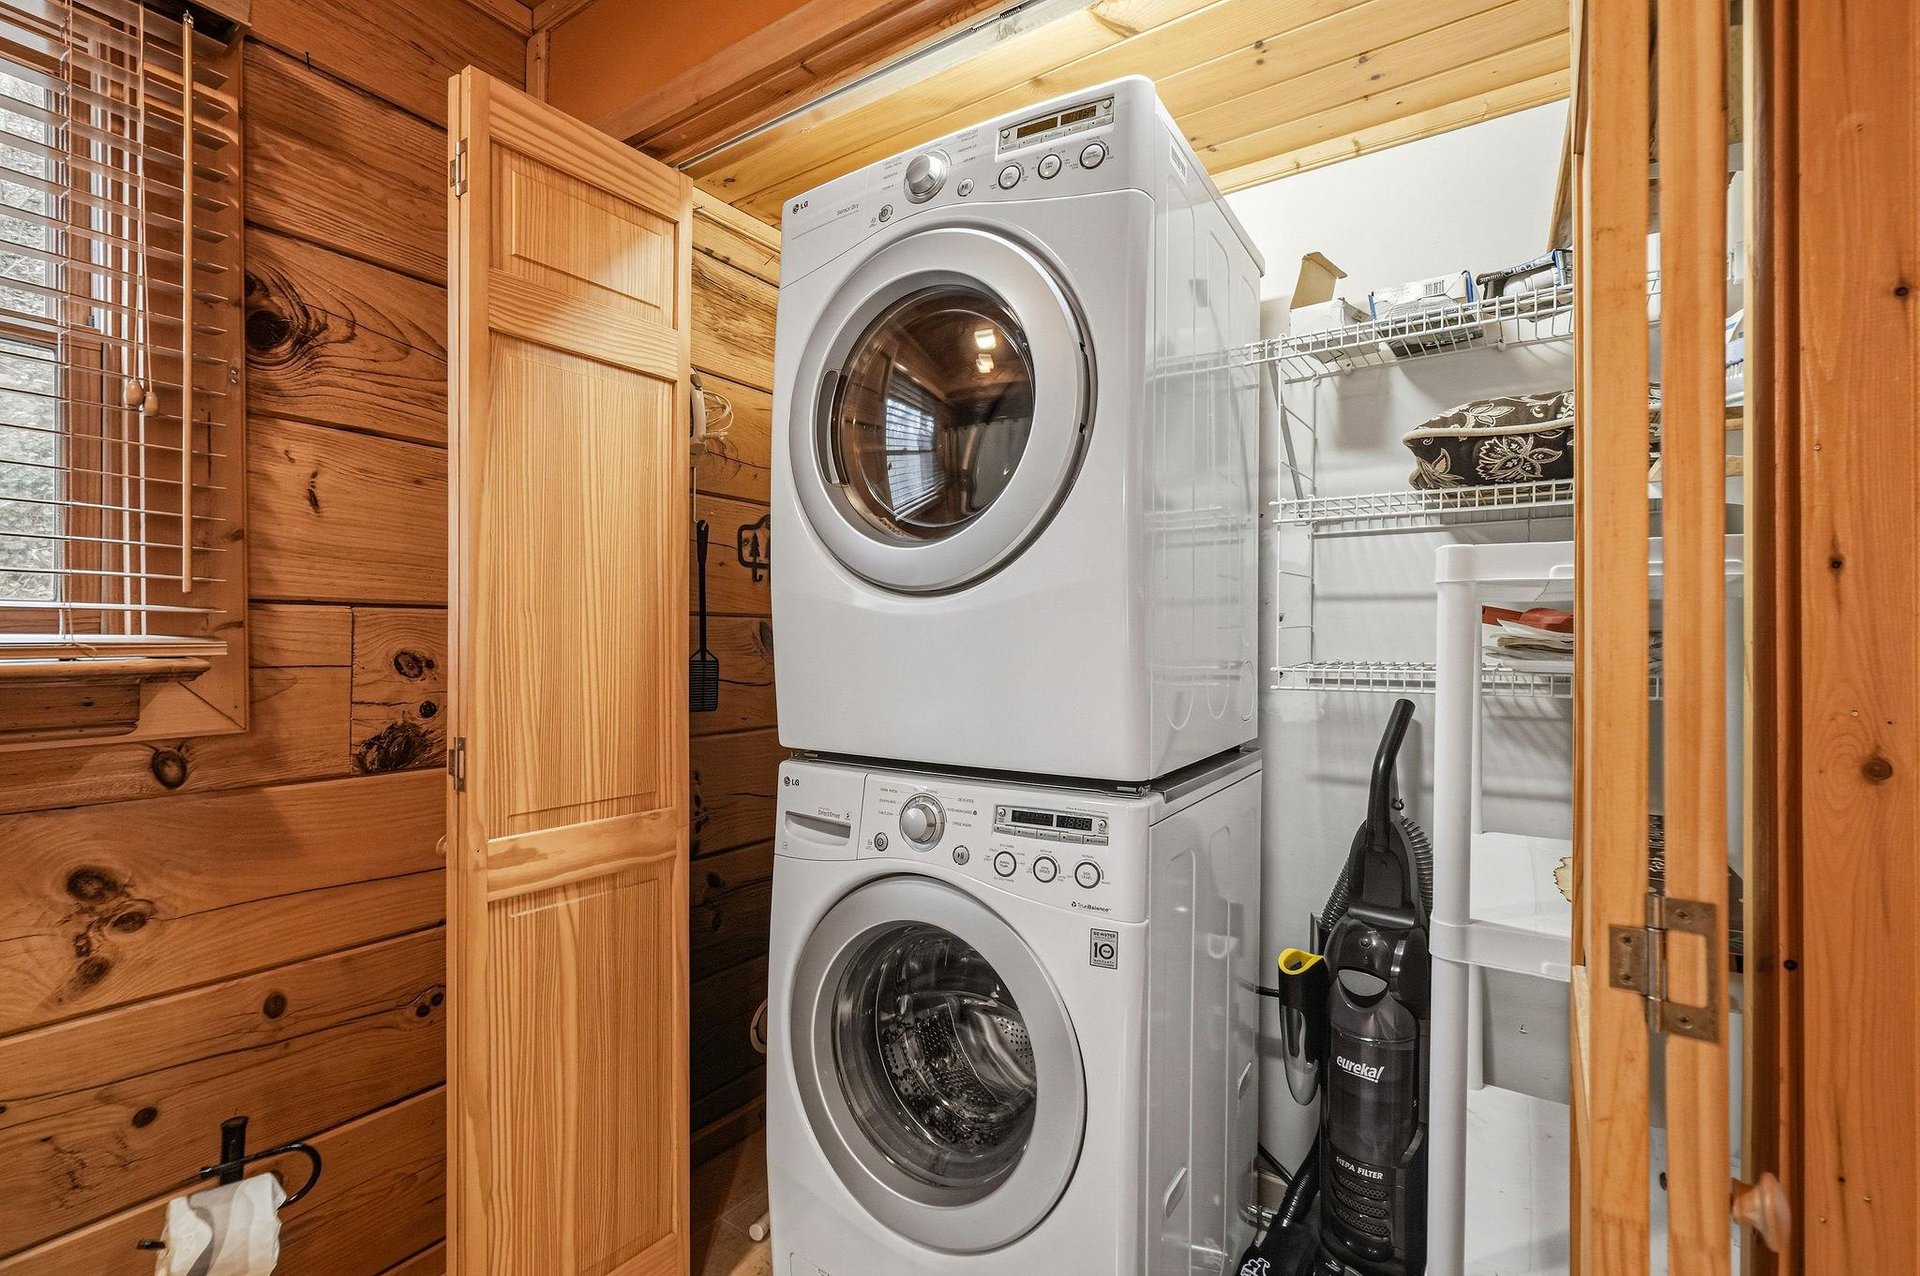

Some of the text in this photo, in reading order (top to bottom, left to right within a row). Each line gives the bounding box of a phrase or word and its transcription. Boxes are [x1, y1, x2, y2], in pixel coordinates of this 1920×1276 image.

[1093, 942, 1115, 960] 10
[1336, 1055, 1385, 1081] eureka!
[1336, 1156, 1384, 1180] HEPA FILTER
